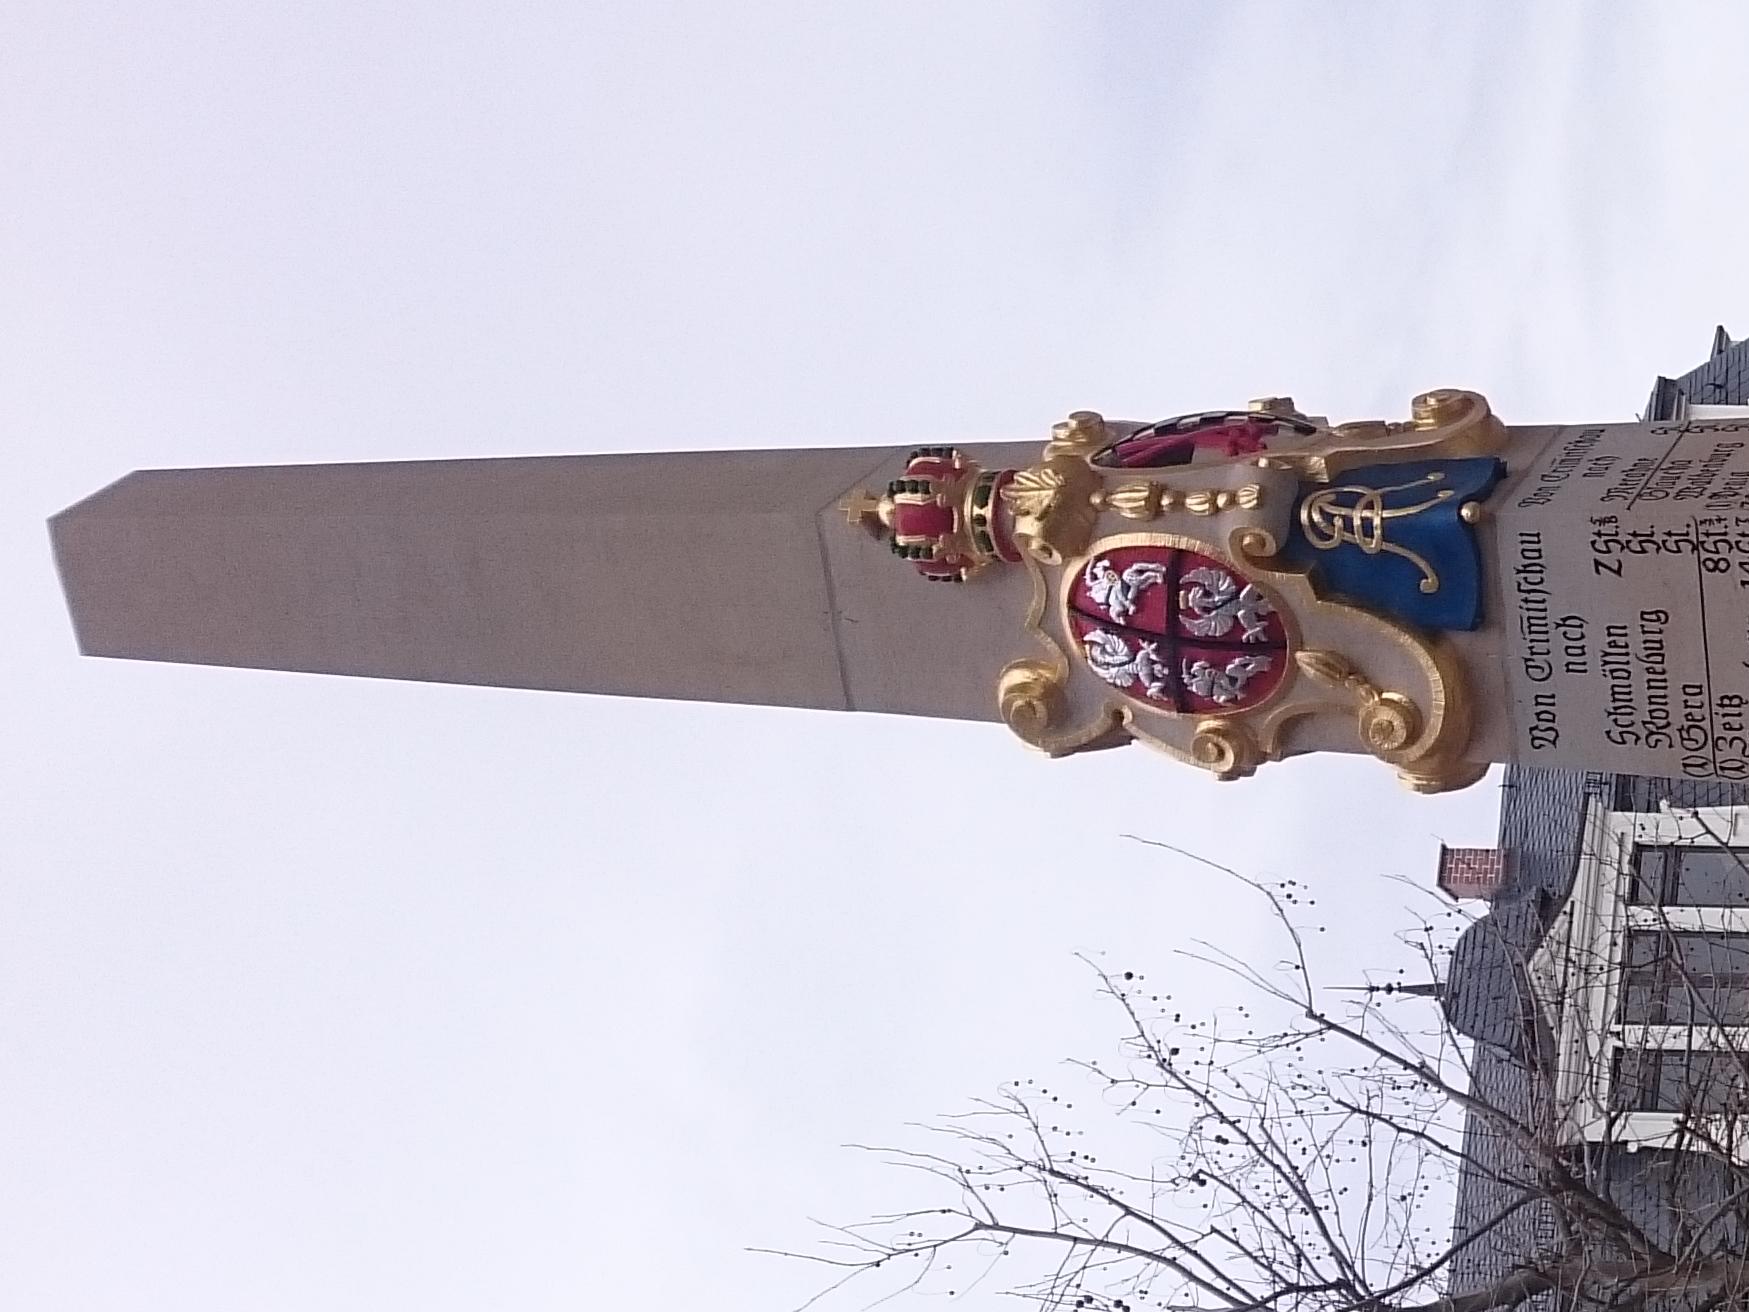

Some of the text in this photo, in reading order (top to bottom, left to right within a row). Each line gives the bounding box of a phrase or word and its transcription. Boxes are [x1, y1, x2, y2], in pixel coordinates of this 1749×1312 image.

[1582, 456, 1621, 478] nach
[1518, 486, 1561, 507] Von
[1625, 525, 1662, 555] St.
[1661, 523, 1698, 555] St.
[1553, 615, 1588, 674] nach
[1529, 694, 1559, 750] Von
